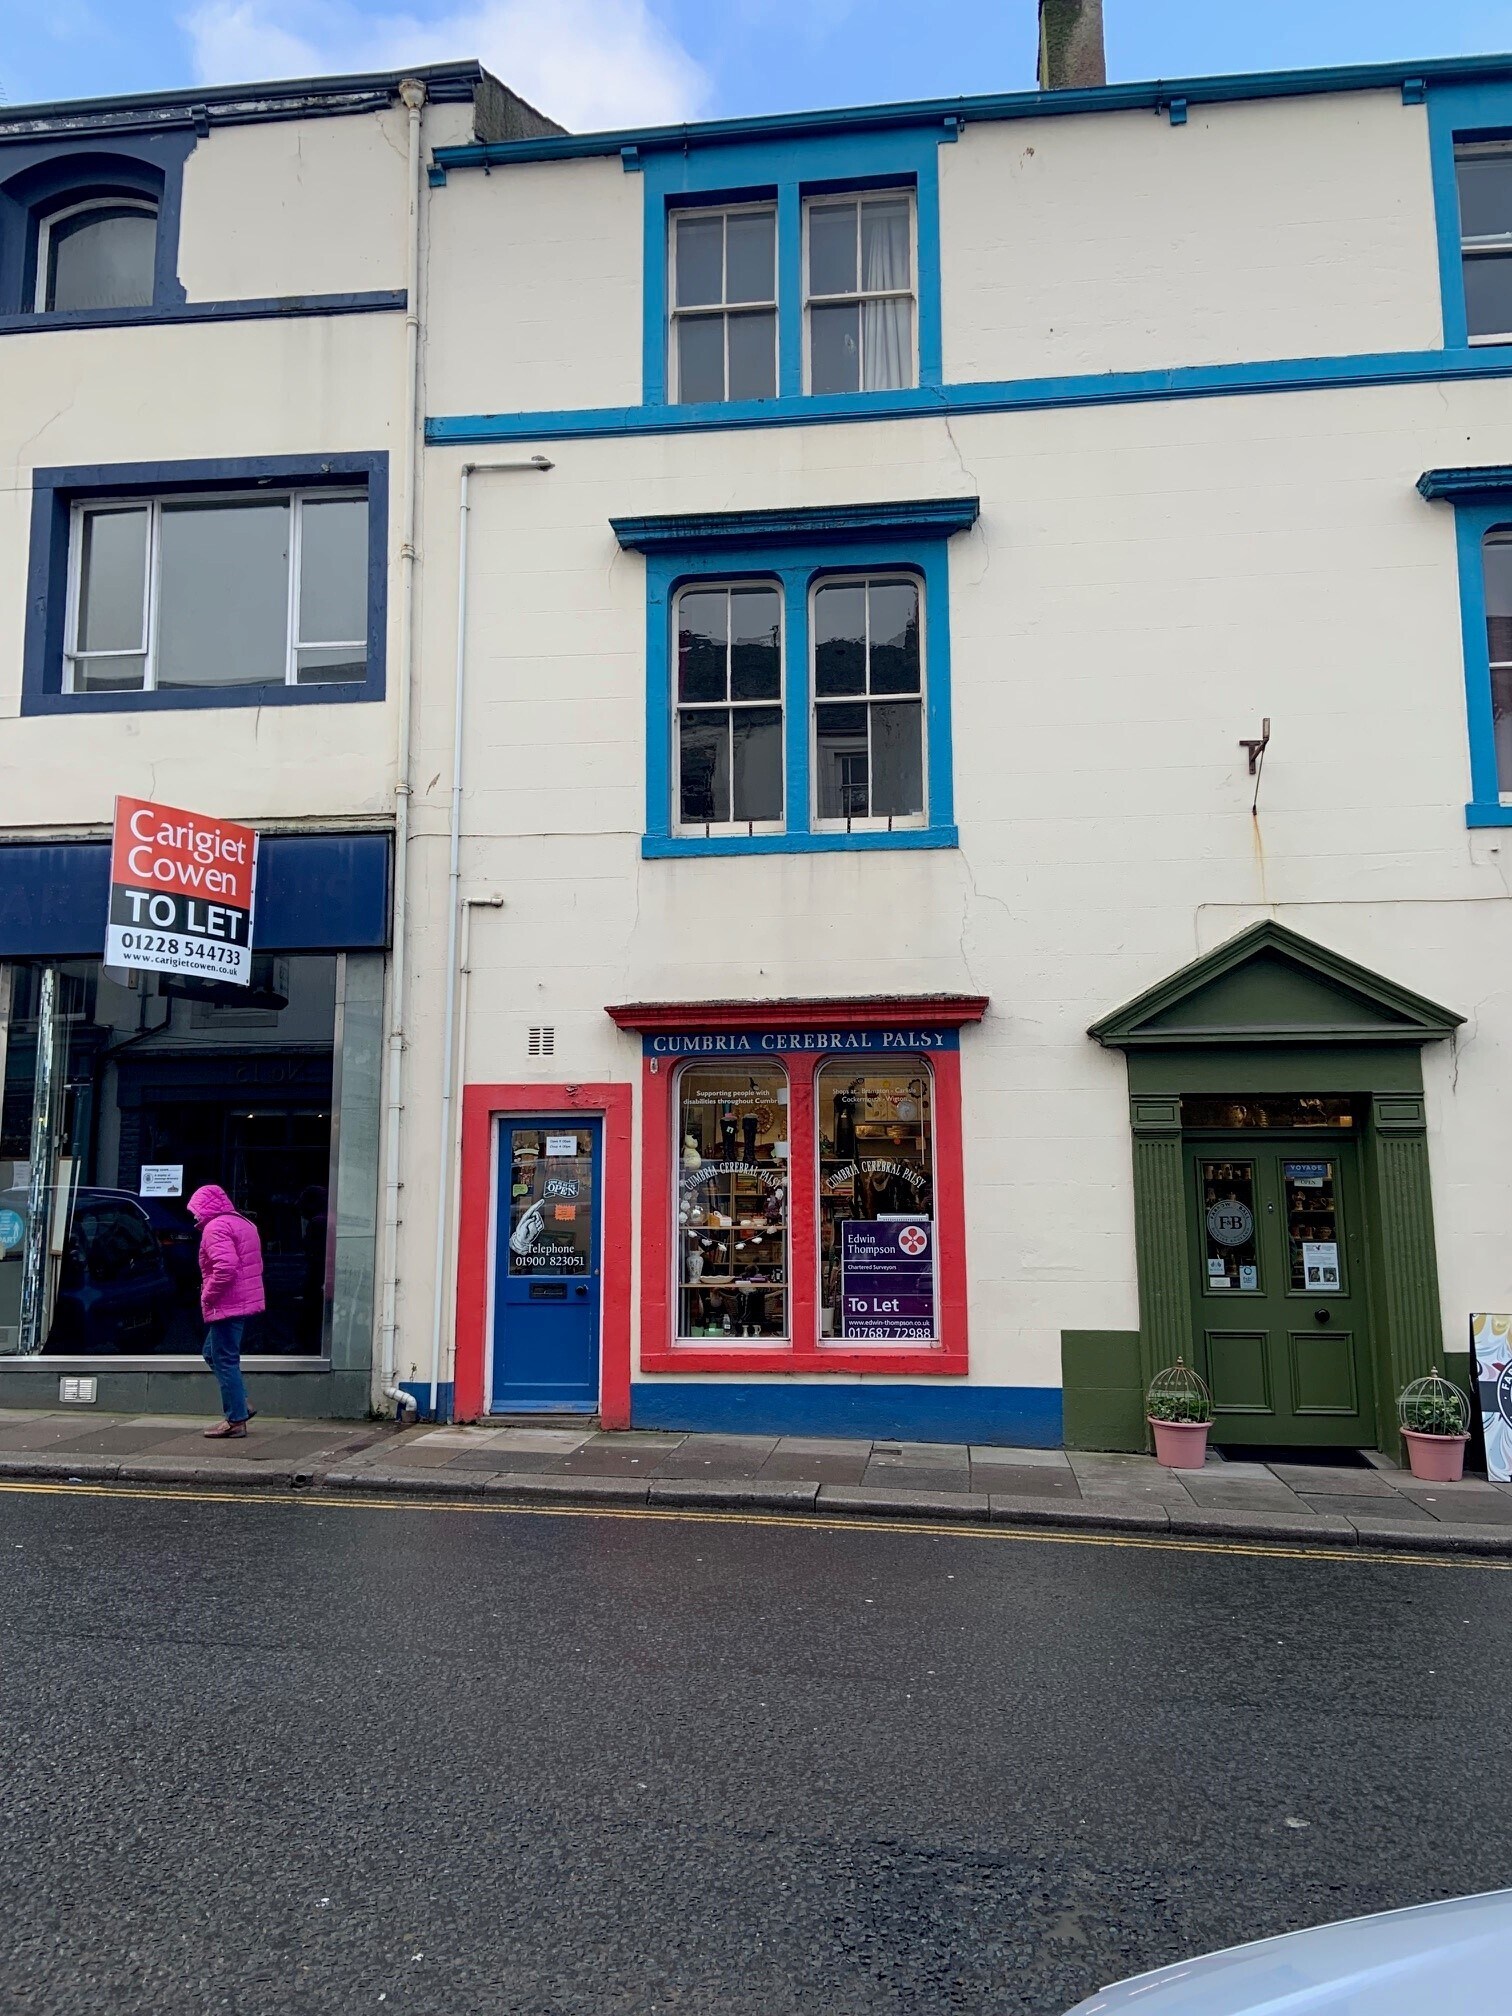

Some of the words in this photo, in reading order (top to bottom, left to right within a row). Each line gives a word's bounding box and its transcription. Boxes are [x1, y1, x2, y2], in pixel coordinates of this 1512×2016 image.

[130, 810, 246, 865] Carigiet
[128, 845, 237, 896] Cowen
[125, 890, 176, 927] TO
[187, 901, 242, 940] LET
[122, 932, 179, 954] 01228
[184, 942, 241, 966] 544733
[123, 952, 238, 977] www.carigietcowen.co.uk
[653, 1035, 751, 1051] CUMBRIA
[761, 1033, 872, 1050] CEREBRAL
[882, 1031, 944, 1047] PALSY
[684, 1165, 718, 1190] CUMBRIA
[719, 1161, 759, 1177] CEREBRAL
[760, 1168, 782, 1190] PALSY
[826, 1163, 860, 1190] CUMBRIA
[861, 1160, 902, 1176] CEREBRAL
[902, 1167, 926, 1189] PALSY
[547, 1184, 576, 1196] OPEN
[1219, 1215, 1243, 1230] F&B
[848, 1233, 876, 1243] Edwin
[528, 1243, 575, 1255] Telephone
[848, 1244, 896, 1257] Thompson
[515, 1256, 546, 1266] 01900
[549, 1256, 585, 1266] 823051
[848, 1298, 868, 1312] To
[873, 1298, 900, 1312] Let
[848, 1327, 890, 1338] 017687
[894, 1327, 931, 1338] 72988
